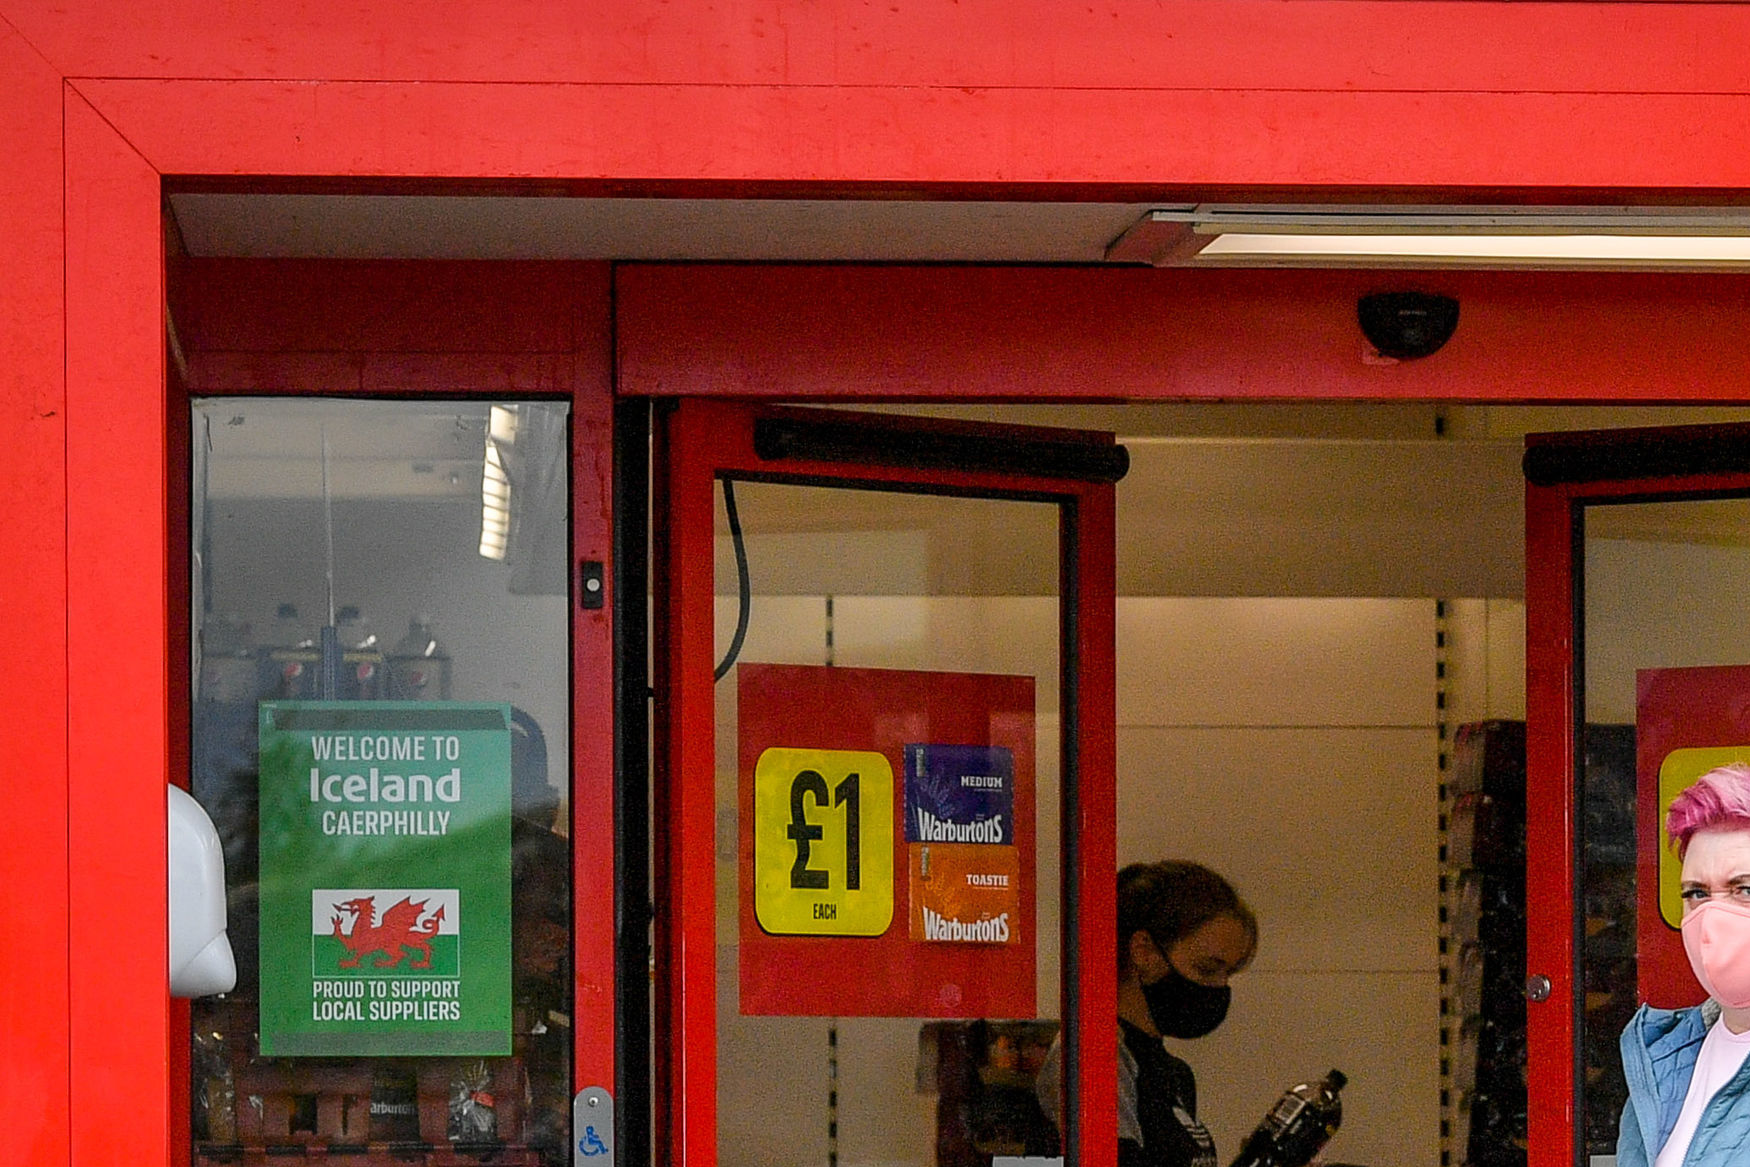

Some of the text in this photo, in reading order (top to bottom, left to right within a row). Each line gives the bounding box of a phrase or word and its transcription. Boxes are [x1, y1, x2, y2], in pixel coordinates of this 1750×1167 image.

[311, 736, 460, 762] WELCOME TO
[310, 767, 461, 803] Iceland
[960, 775, 1003, 788] MEDIUM
[321, 811, 450, 837] CAERPHILLY
[786, 769, 861, 891] £1
[917, 807, 1003, 843] Warburtons
[965, 873, 1009, 887] TOASTIE
[812, 903, 837, 920] EACH
[922, 905, 1010, 943] Warburtons
[312, 980, 461, 1000] PROUD TO SUPPORT
[312, 1001, 461, 1021] LOCAL SUPPLIERS
